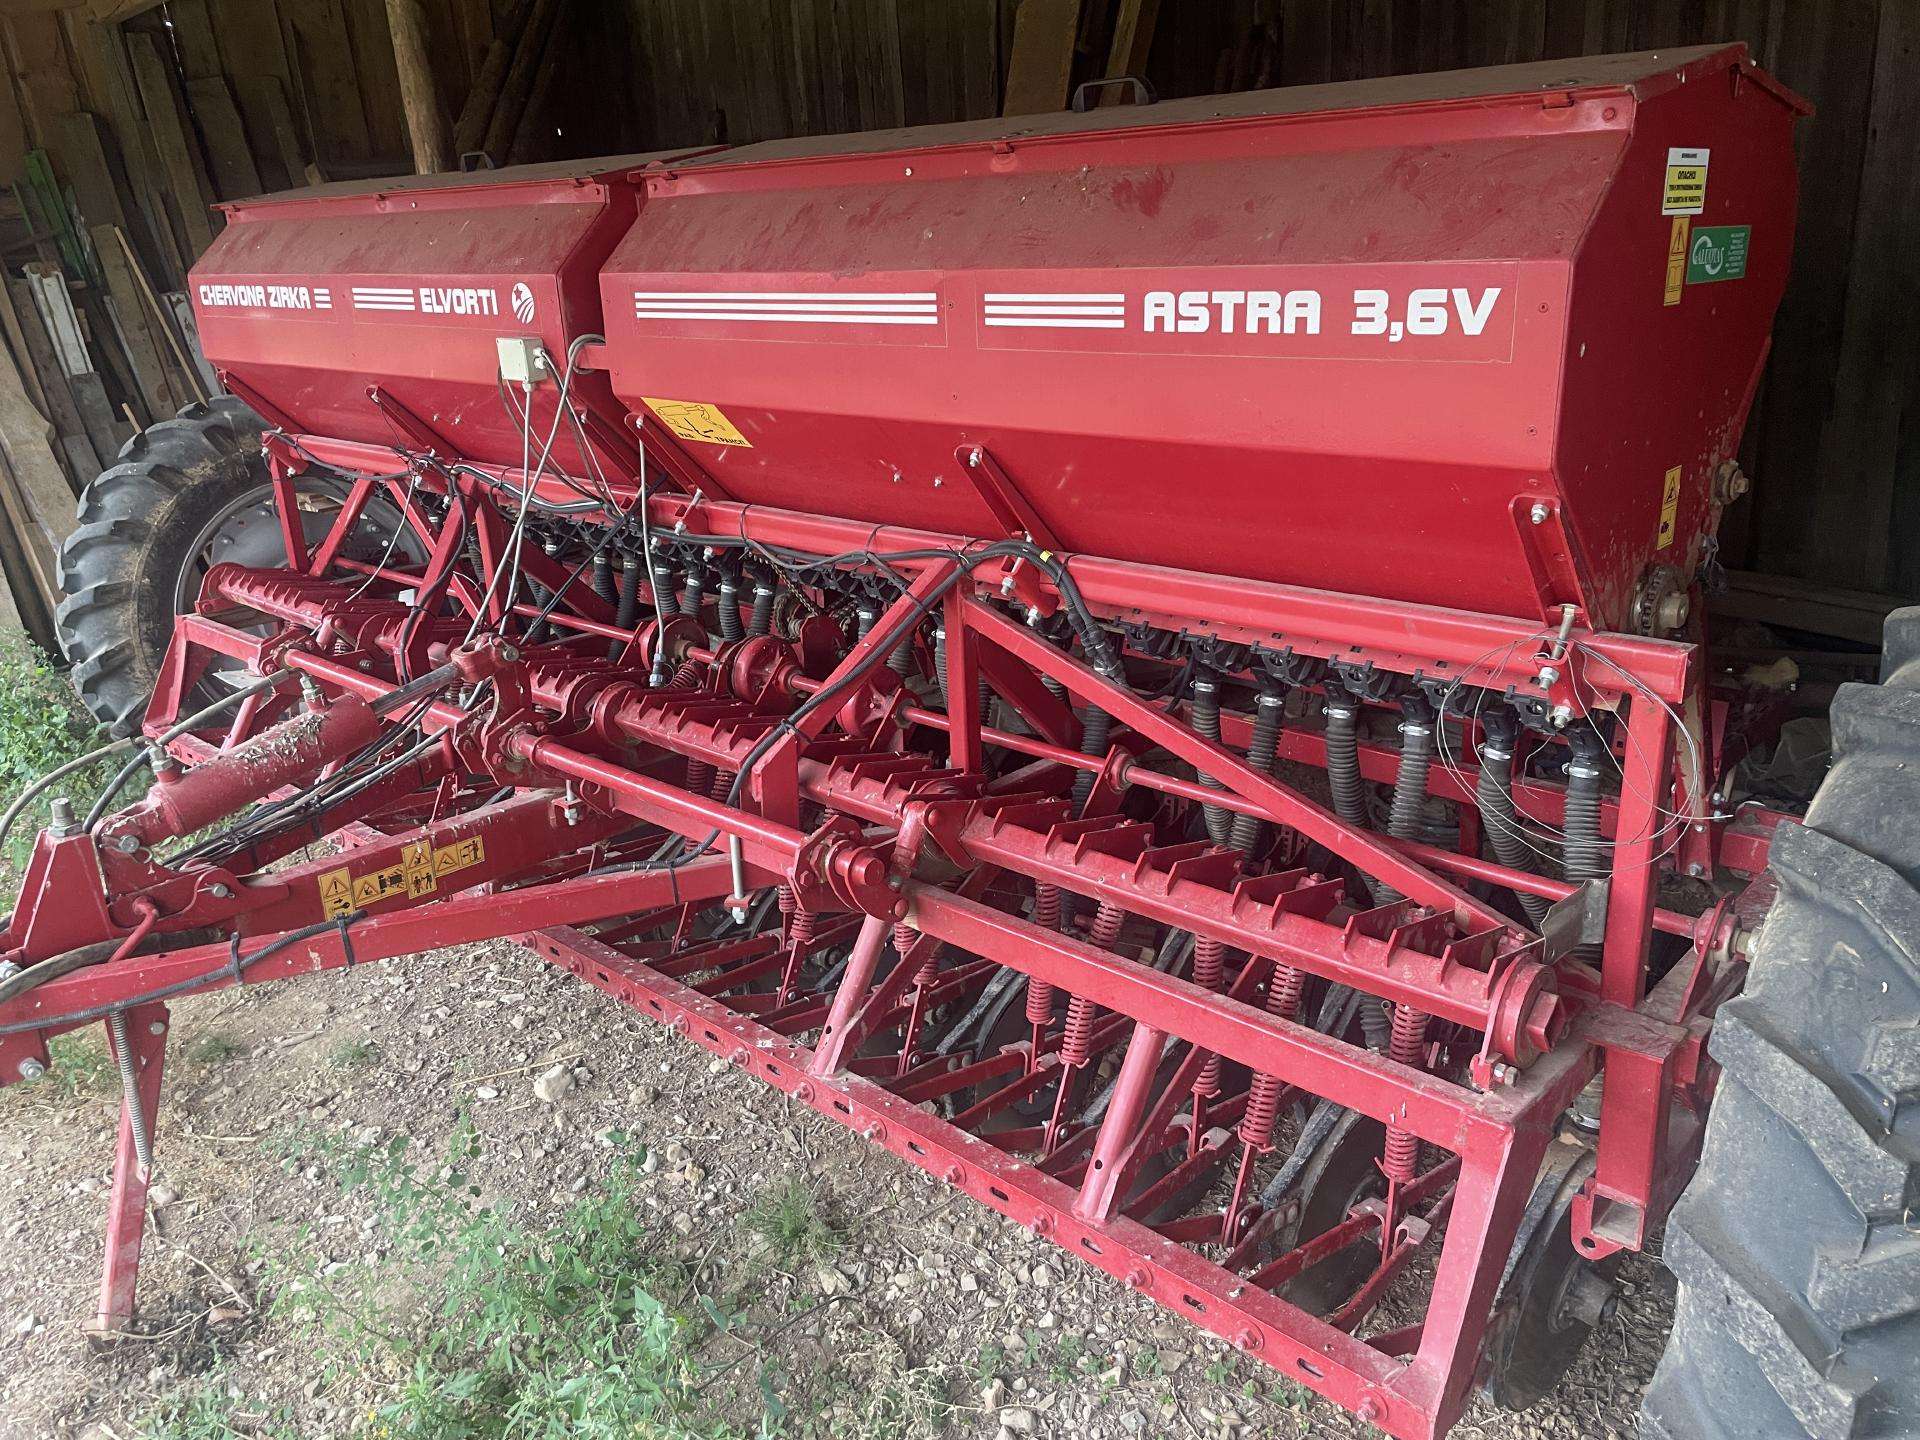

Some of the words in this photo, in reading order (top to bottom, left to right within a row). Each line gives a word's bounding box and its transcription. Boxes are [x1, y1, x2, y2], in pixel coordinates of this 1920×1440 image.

[200, 285, 265, 308] CHERVONA
[267, 285, 311, 309] ZIRKA
[419, 288, 499, 315] ELVORTI
[1143, 290, 1321, 334] ASTRA
[1351, 288, 1502, 342] 3,6V
